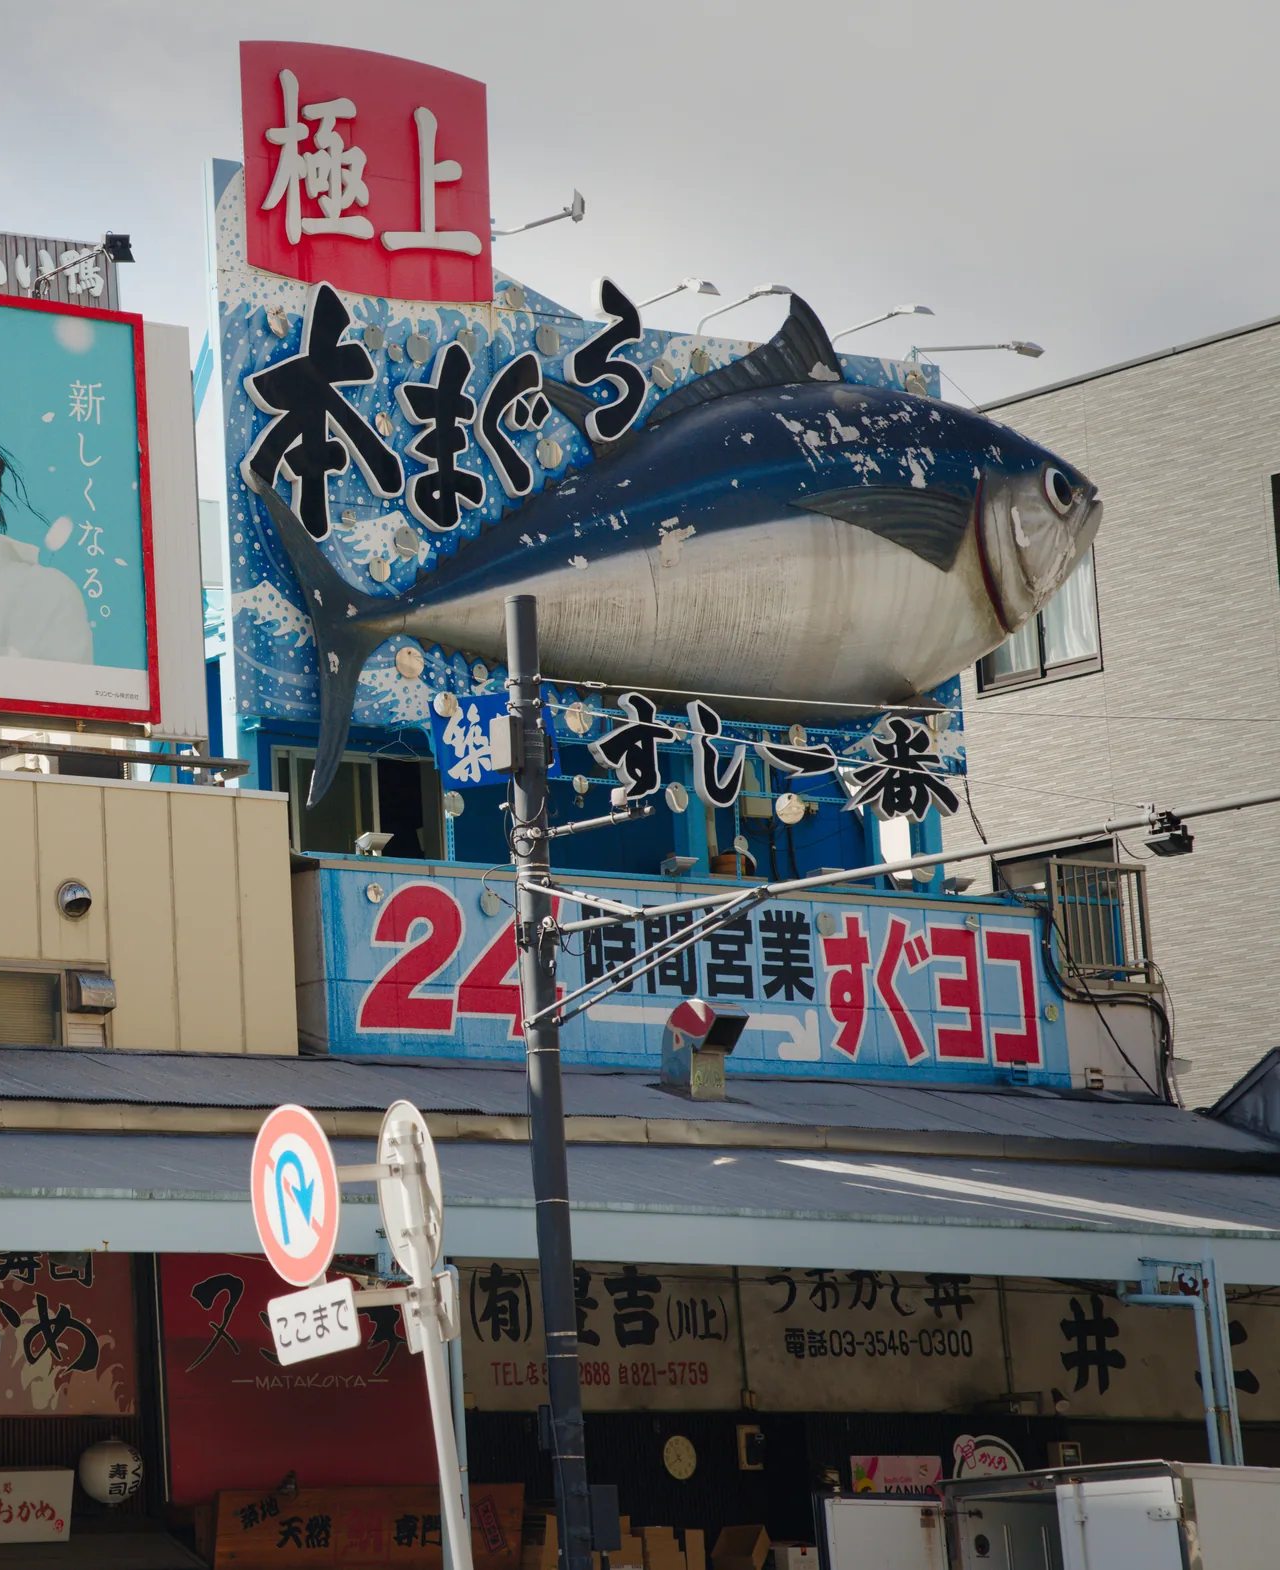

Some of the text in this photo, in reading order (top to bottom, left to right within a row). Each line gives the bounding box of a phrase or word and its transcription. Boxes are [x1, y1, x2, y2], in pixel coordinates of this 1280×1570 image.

[261, 68, 483, 256] 極上
[243, 275, 647, 543] 本まぐろ
[69, 380, 111, 617] 新しくなる。
[588, 692, 960, 823] すし一番
[821, 911, 1045, 1069] すぐヨコ
[255, 1375, 367, 1390] MATAKOIYA
[276, 1299, 349, 1348] ここまで
[784, 1327, 973, 1359] 電話03-3546-0300
[108, 1462, 129, 1497] 寿司
